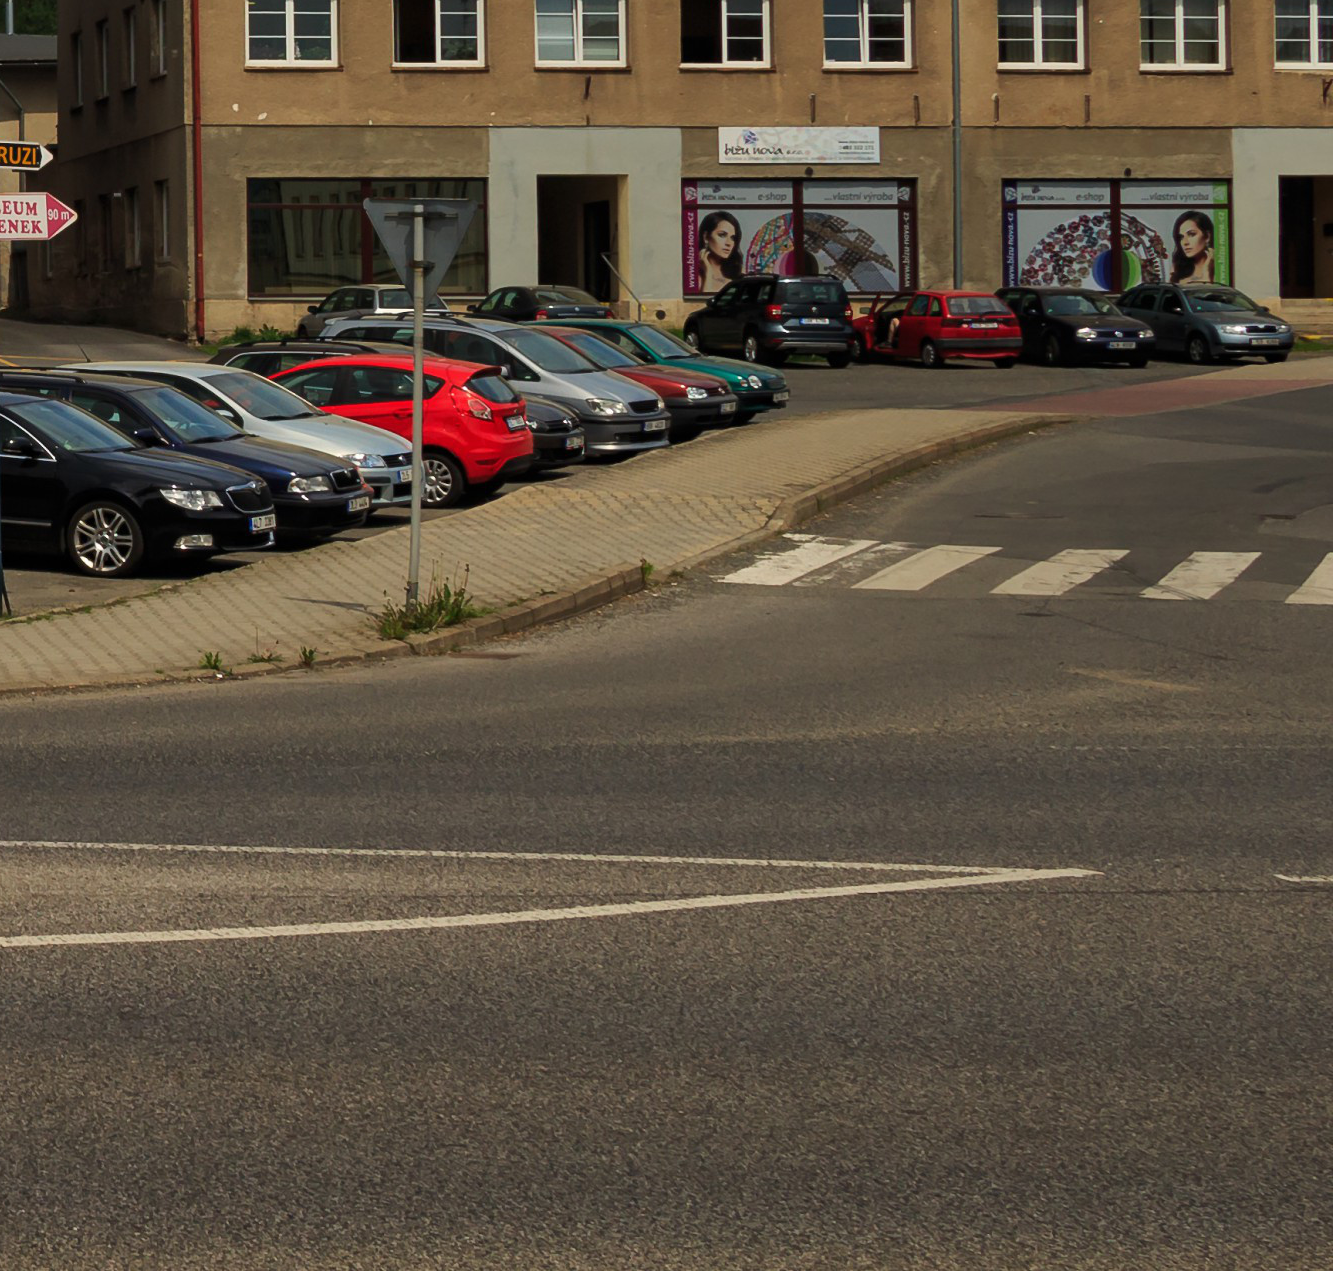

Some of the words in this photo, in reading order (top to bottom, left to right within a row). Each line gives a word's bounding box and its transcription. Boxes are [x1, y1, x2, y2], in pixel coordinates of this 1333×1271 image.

[753, 146, 784, 155] nova
[758, 192, 787, 201] e-shop
[863, 192, 893, 202] výroba
[1076, 192, 1104, 202] e-shop
[1180, 192, 1209, 202] výroba
[47, 209, 58, 220] 90
[61, 211, 70, 220] m
